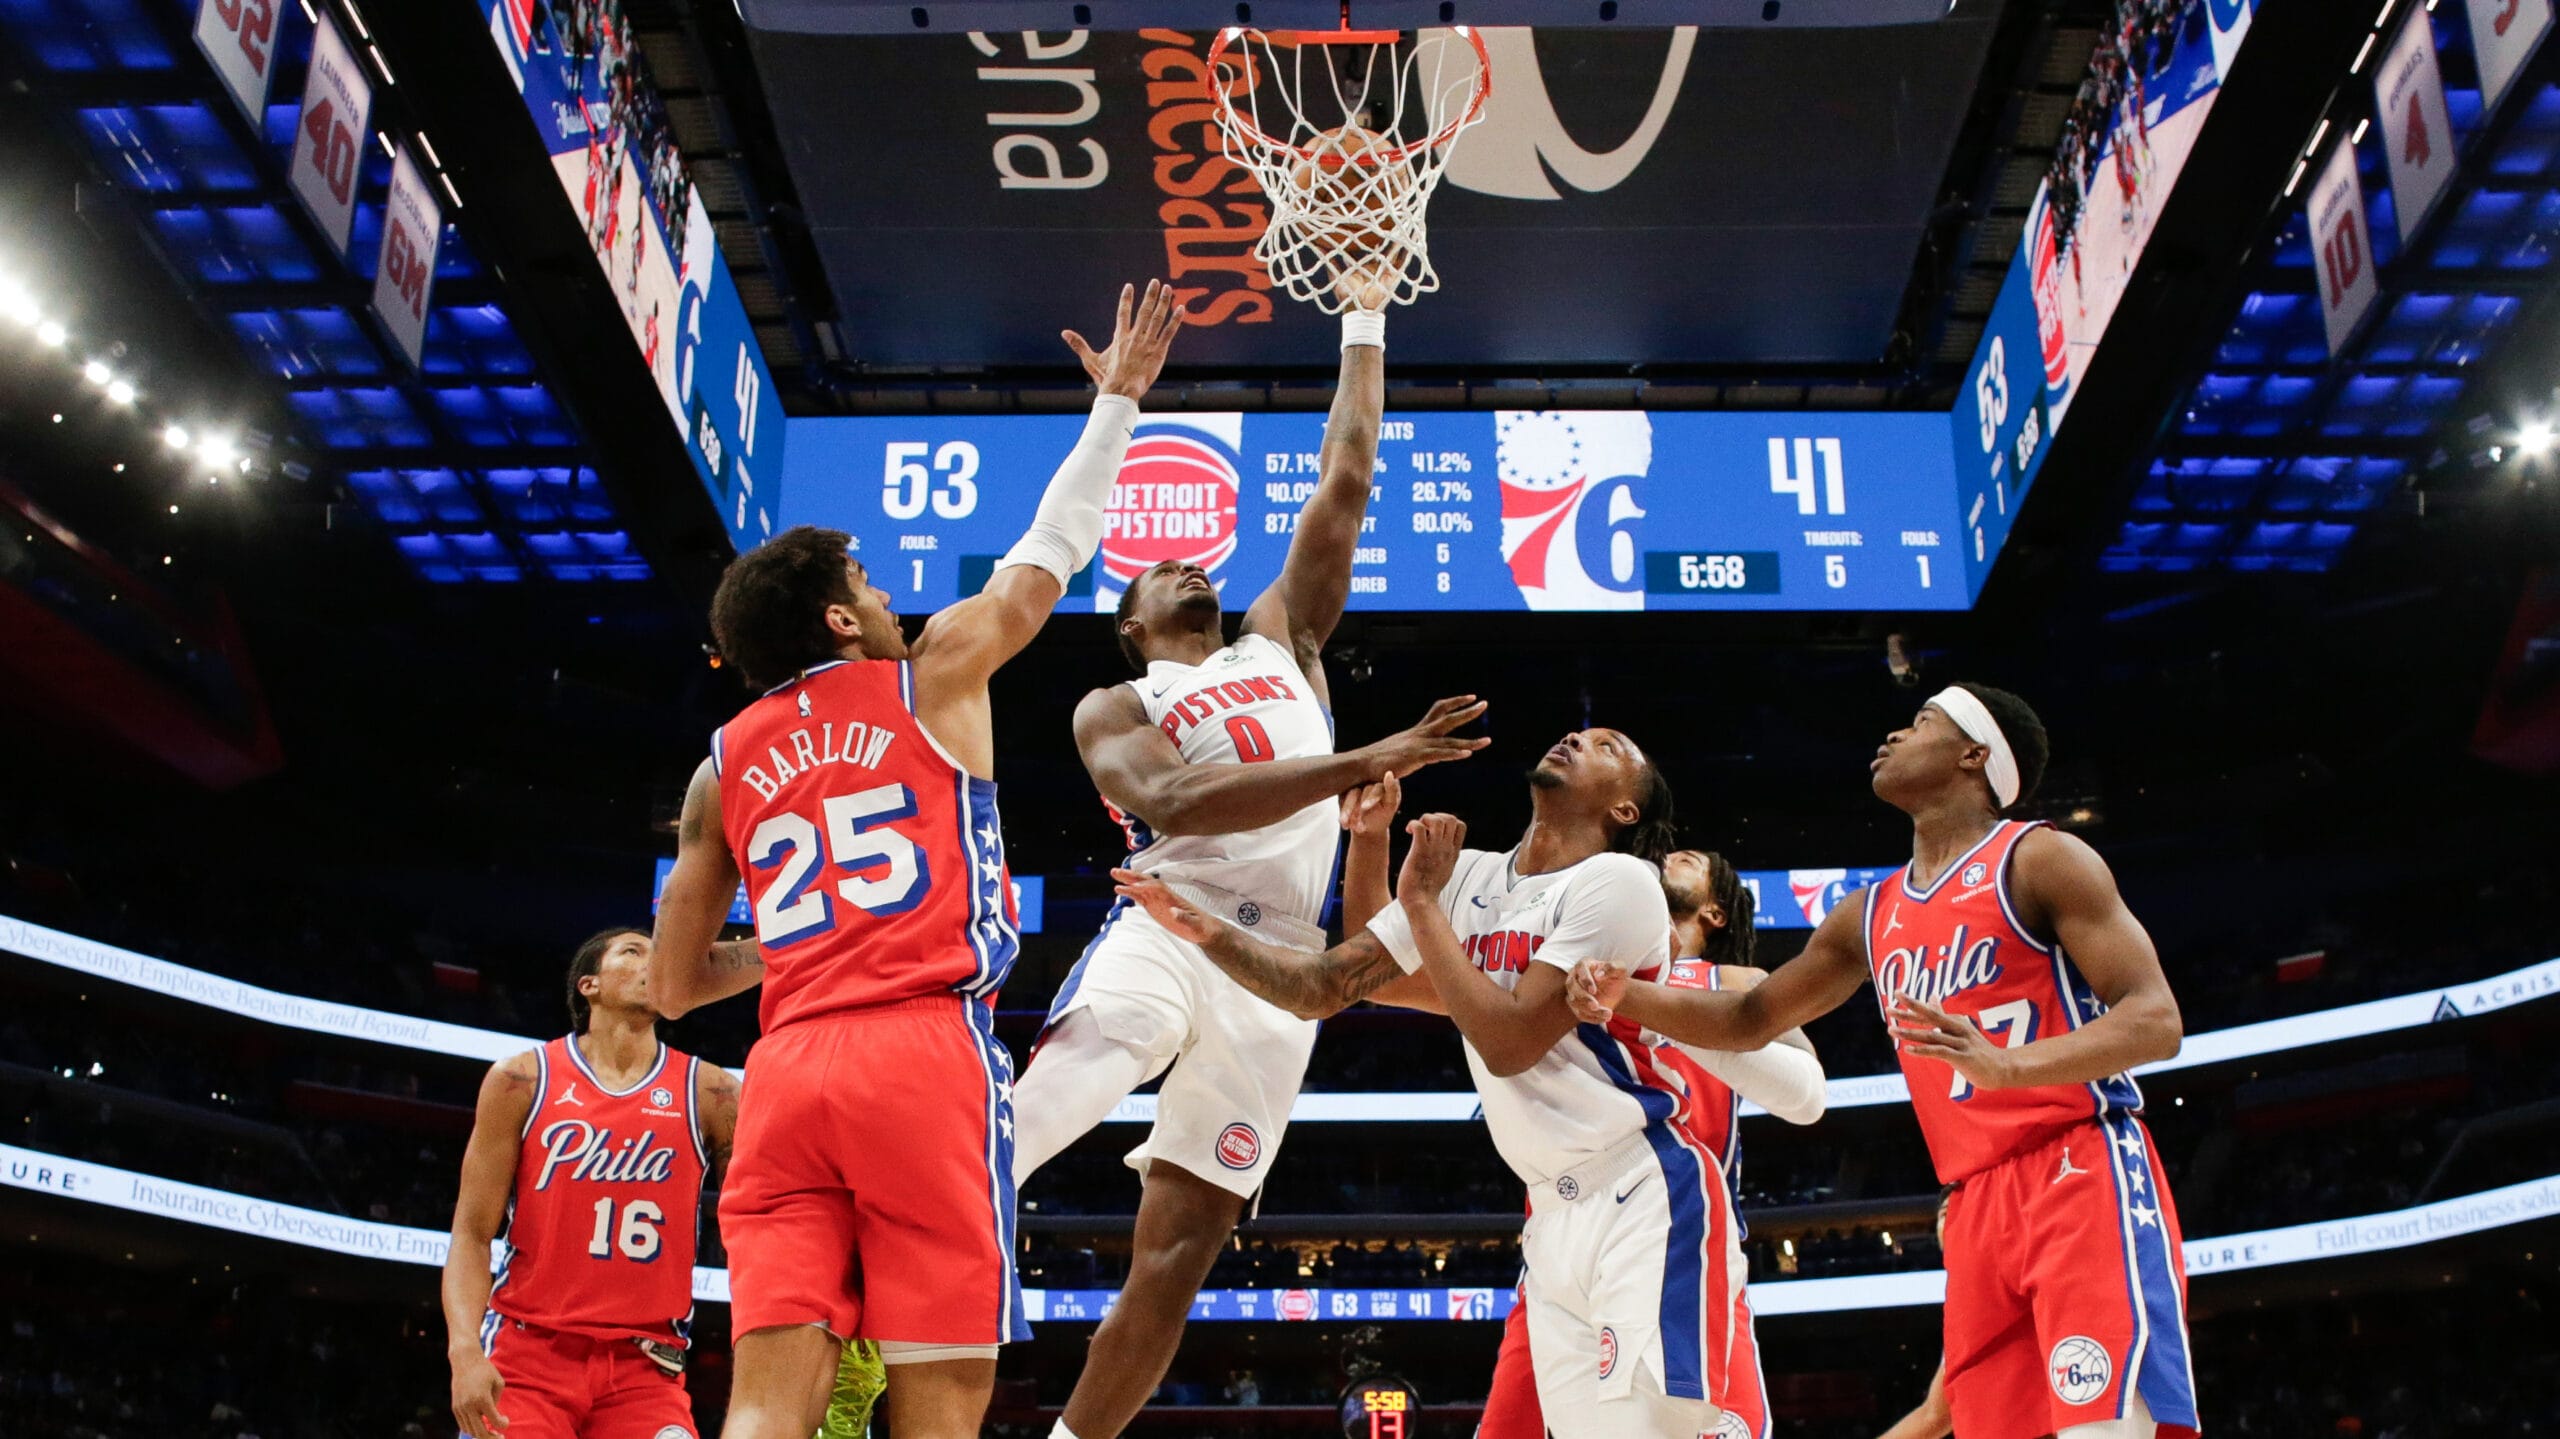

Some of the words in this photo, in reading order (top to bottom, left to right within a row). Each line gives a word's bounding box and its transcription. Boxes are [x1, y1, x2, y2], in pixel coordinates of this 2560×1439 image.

[2404, 90, 2431, 169] 4
[305, 98, 356, 206] 40
[1138, 28, 1290, 327] aesars
[2323, 209, 2362, 311] 10
[734, 341, 760, 458] 41
[1976, 335, 2008, 454] 53
[1411, 452, 1473, 473] 41.2%
[1768, 437, 1846, 516] 41
[882, 440, 981, 521] 53
[1106, 483, 1220, 511] DETROIT
[1411, 482, 1473, 503] 26.7%
[1102, 511, 1221, 540] PISTONS
[1412, 513, 1474, 534] 90.0%
[1803, 531, 1864, 547] TIMEOUTS:
[1900, 531, 1941, 547] FOULS:
[899, 535, 939, 551] FOULS:
[1436, 543, 1450, 564] 5
[912, 559, 925, 593] 1
[1436, 571, 1451, 593] 8
[1678, 555, 1746, 590] 5:58
[1824, 555, 1847, 589] 5
[1916, 554, 1931, 589] 1
[1160, 675, 1298, 750] PISTONS
[1224, 715, 1276, 764] 0
[741, 721, 896, 803] BARLOW
[747, 782, 933, 951] 25
[1951, 881, 1995, 903] crypto.com
[1878, 924, 2005, 1050] Phila
[641, 1106, 682, 1118] crypto.com
[534, 1118, 677, 1192] Phila
[131, 1177, 243, 1223] Insurance,
[245, 1203, 392, 1254] Cybersecurity,
[588, 1196, 666, 1264] 16
[2314, 1219, 2422, 1251] Full-court
[2425, 1189, 2515, 1231] business
[1331, 1292, 1358, 1317] 53
[1409, 1292, 1431, 1316] 41
[2055, 1363, 2105, 1389] 76ers
[1364, 1390, 1406, 1412] 5:58
